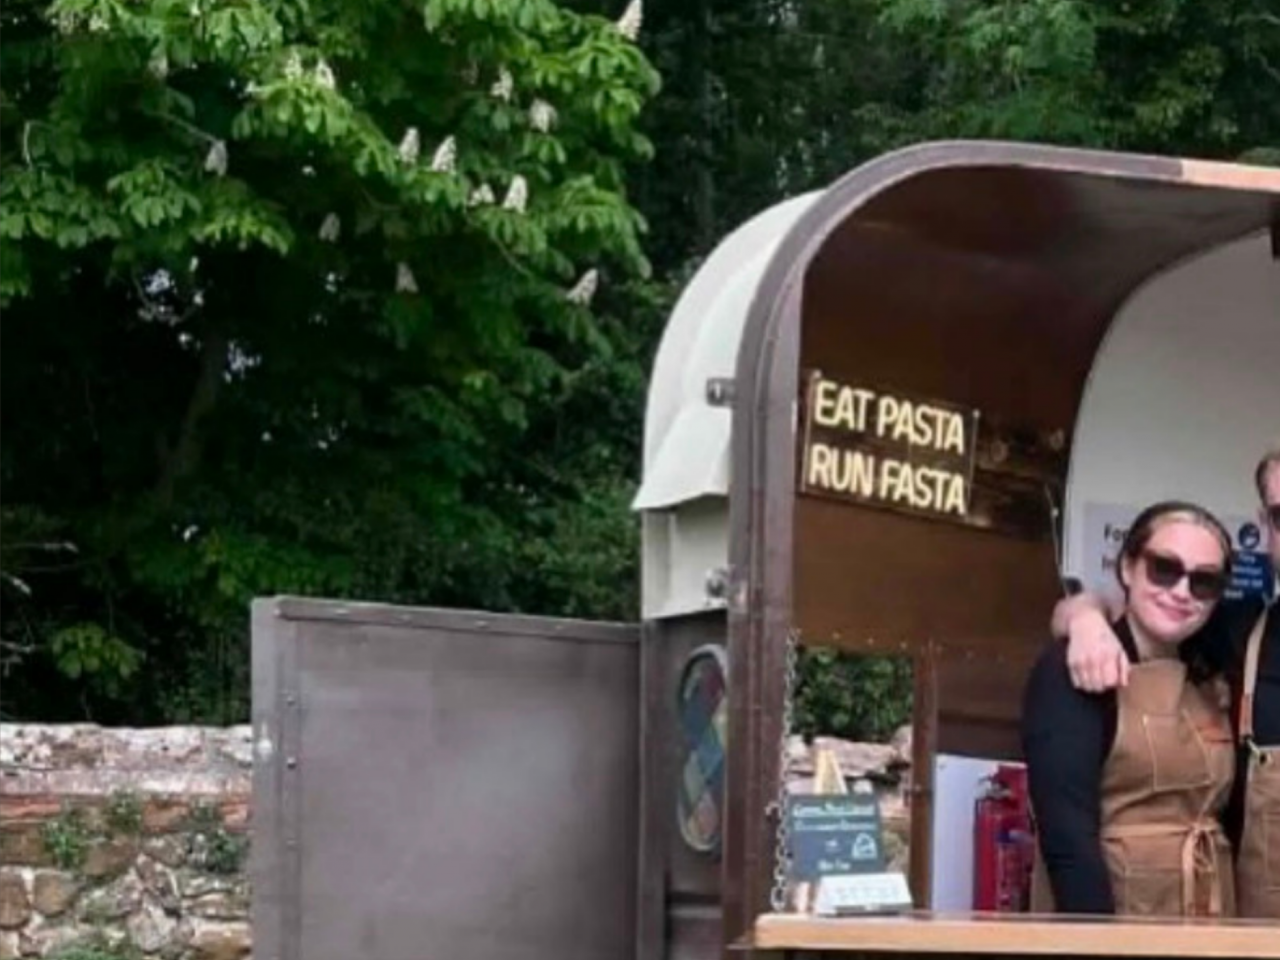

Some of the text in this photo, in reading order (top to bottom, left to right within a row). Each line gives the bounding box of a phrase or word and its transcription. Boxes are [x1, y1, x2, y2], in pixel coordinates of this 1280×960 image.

[814, 380, 964, 455] EAT PASTA
[808, 443, 967, 516] RUN FASTA
